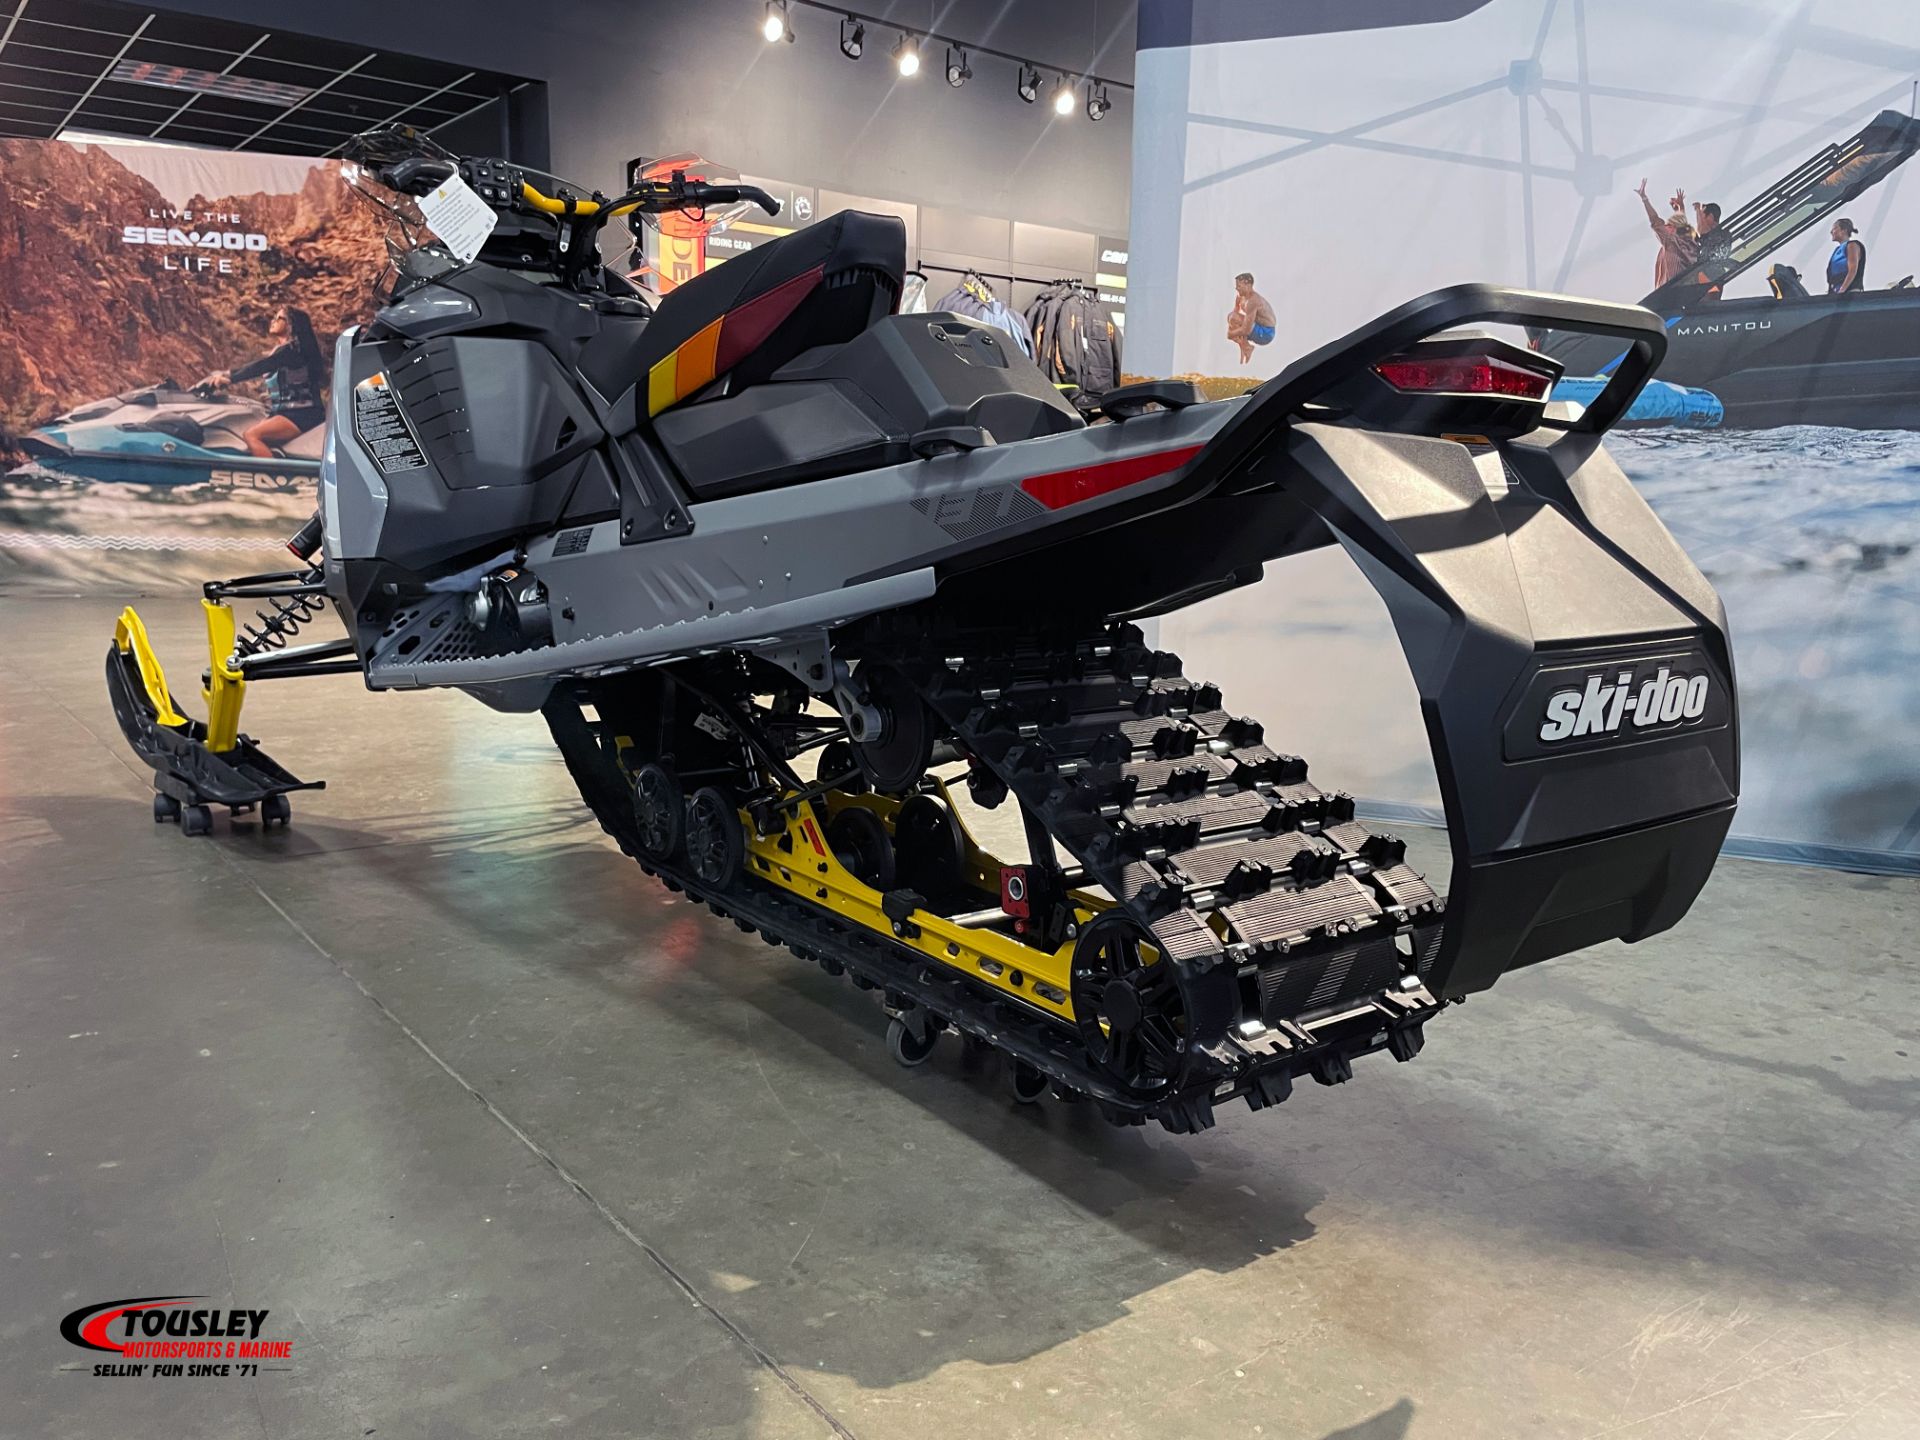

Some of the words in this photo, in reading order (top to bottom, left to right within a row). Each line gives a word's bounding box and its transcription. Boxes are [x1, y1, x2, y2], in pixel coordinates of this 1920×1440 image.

[149, 208, 193, 221] LIVE
[203, 211, 241, 224] THE
[708, 236, 733, 248] RIDING
[733, 239, 752, 251] GEAR
[163, 255, 233, 274] LIFE
[1677, 320, 1772, 337] MANITOU
[1539, 667, 1710, 741] ski-doo
